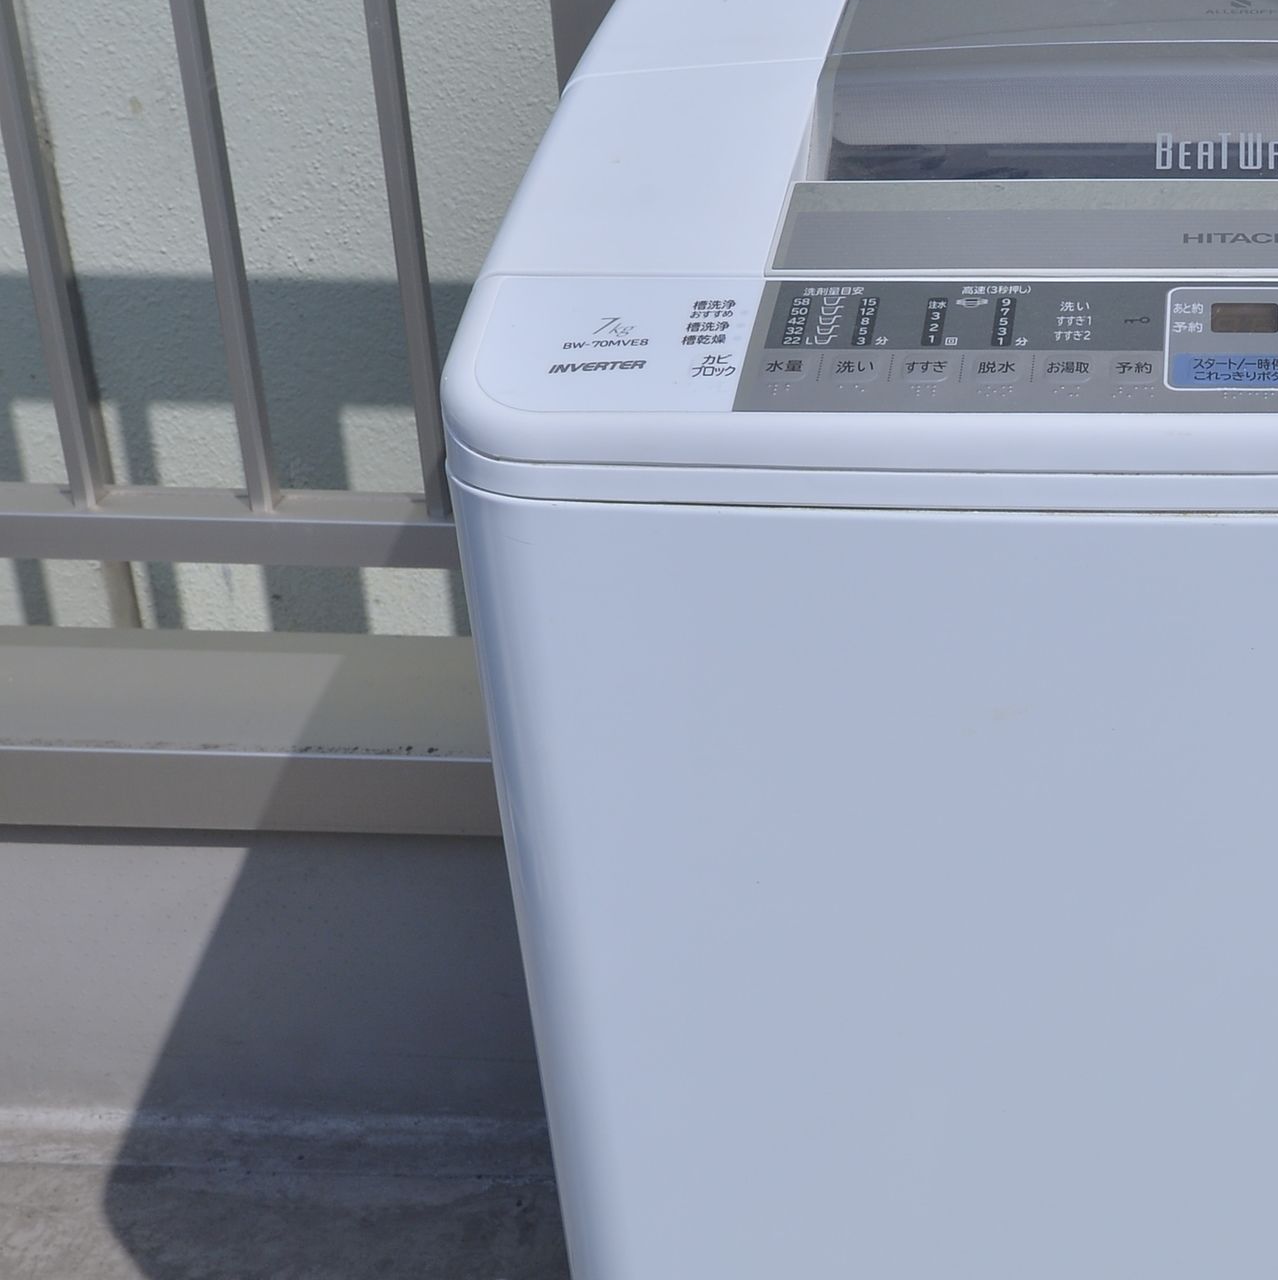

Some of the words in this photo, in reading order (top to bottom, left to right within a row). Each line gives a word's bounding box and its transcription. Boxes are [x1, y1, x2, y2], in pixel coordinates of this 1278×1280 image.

[803, 287, 864, 296] 洗剤量目安
[961, 285, 1032, 295] 高速(3秒押し)
[693, 300, 736, 310] 槽洗浄
[793, 298, 810, 306] 58
[862, 298, 876, 306] 15
[928, 300, 947, 309] 注水
[1002, 298, 1010, 306] 9
[1060, 301, 1090, 312] 洗い
[1001, 308, 1009, 316] 7
[1173, 303, 1203, 314] あと約
[689, 310, 733, 318] おすすめ
[931, 312, 940, 320] 3
[788, 317, 805, 325] 42
[861, 317, 870, 325] 8
[1057, 316, 1092, 326] すすぎ1
[686, 322, 729, 332] 槽洗浄
[859, 327, 867, 335] 5
[1173, 322, 1203, 333] 予約
[681, 335, 726, 345] 槽乾燥
[875, 336, 888, 346] 分
[945, 337, 958, 345] 回
[1054, 331, 1091, 341] すすぎ2
[1015, 337, 1028, 346] 分
[702, 354, 732, 365] カビ
[549, 360, 646, 374] INVERTER
[691, 365, 736, 377] ブロック
[766, 360, 802, 372] 水量
[836, 360, 874, 373] 洗い
[906, 360, 948, 373] すすぎ
[978, 361, 1015, 373] 脱水
[1047, 361, 1089, 373] お湯取
[1115, 362, 1153, 374] 予約
